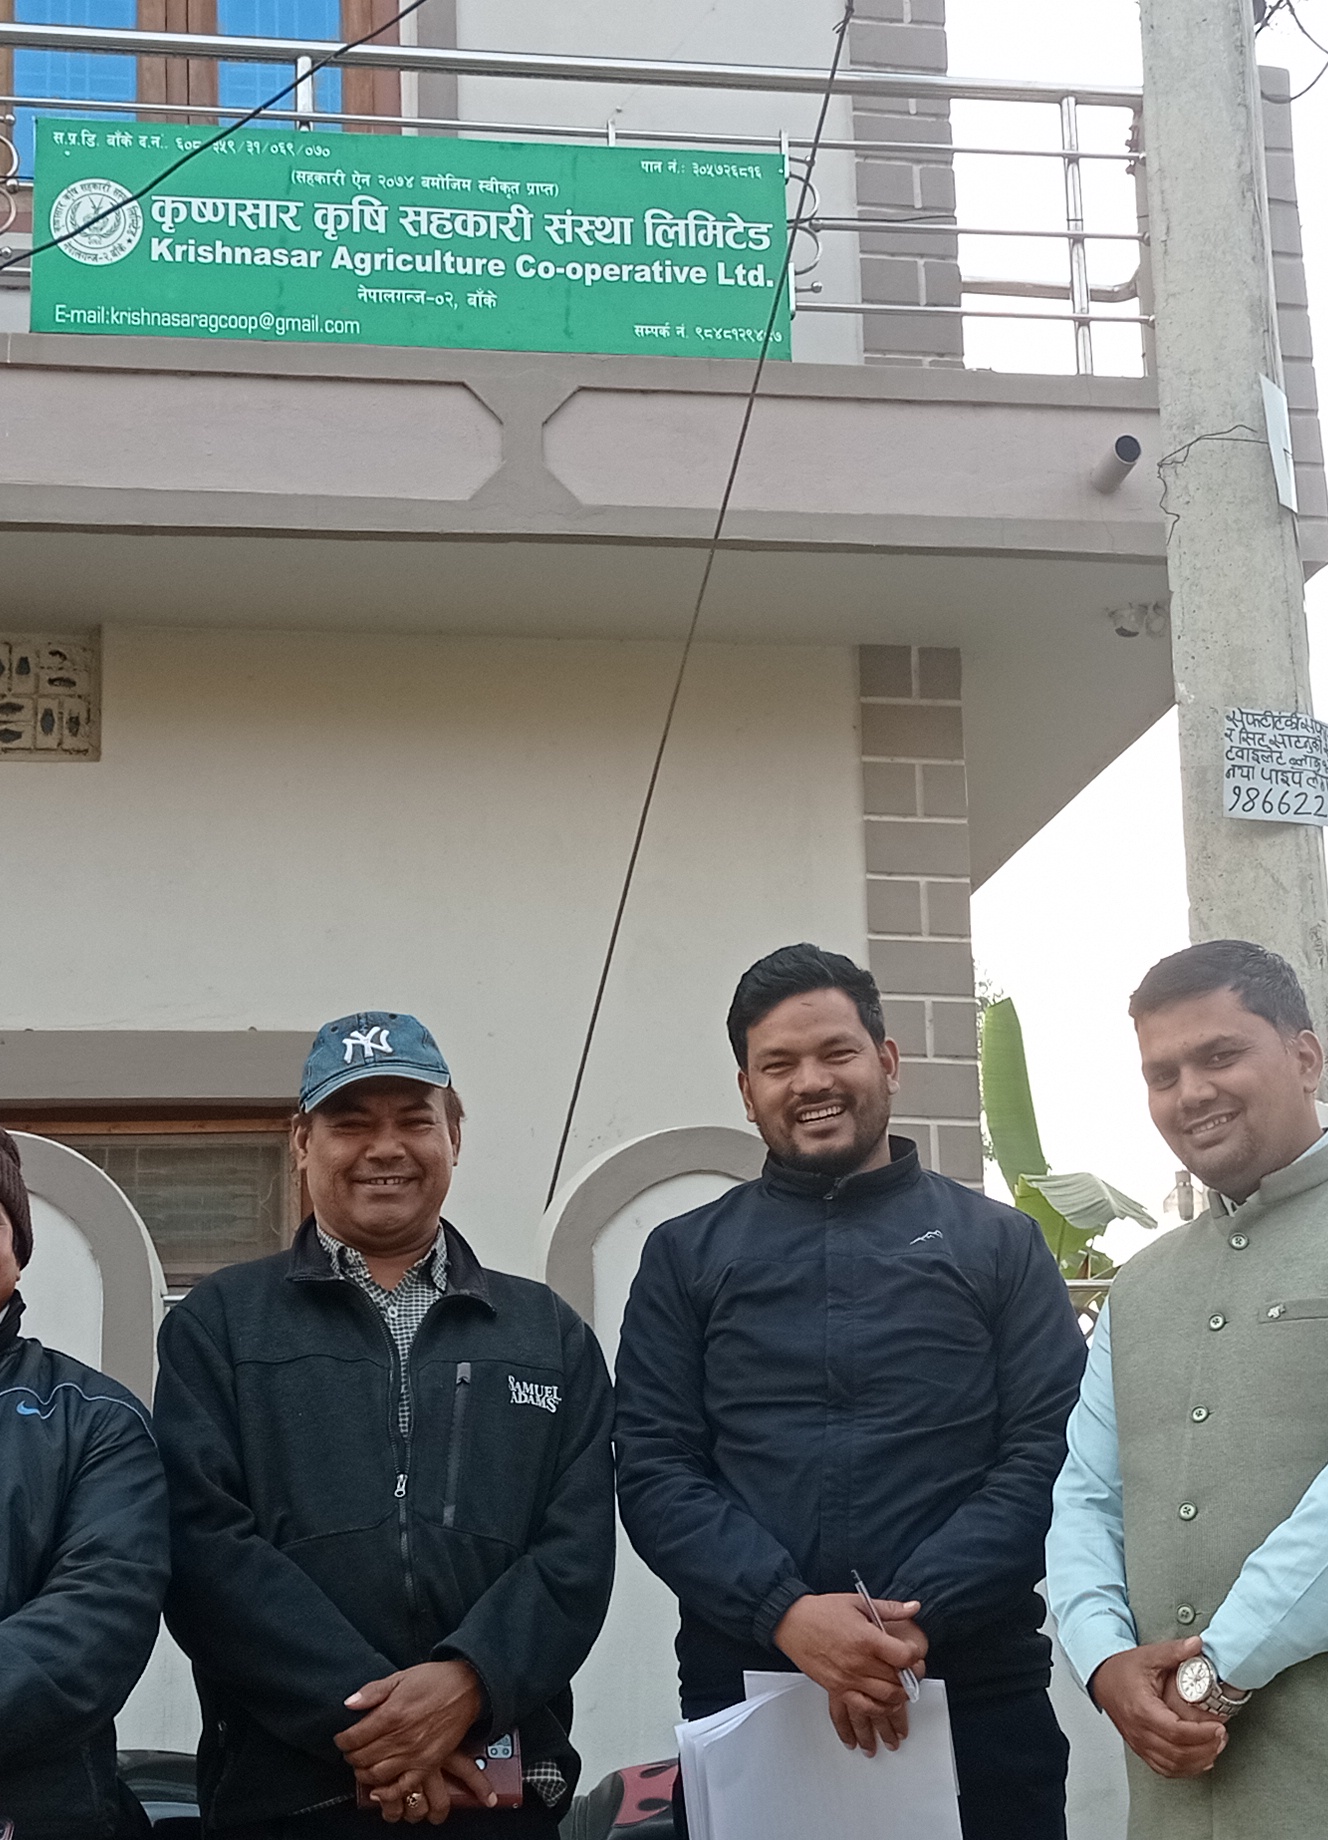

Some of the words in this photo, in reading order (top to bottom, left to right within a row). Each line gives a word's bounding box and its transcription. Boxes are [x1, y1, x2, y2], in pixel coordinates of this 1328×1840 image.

[107, 130, 133, 147] बाँके
[641, 161, 662, 172] पान
[292, 169, 346, 186] (सहकारी
[352, 170, 371, 190] ऐन
[378, 175, 414, 188] २०७४
[421, 174, 472, 191] बमोजिम
[478, 177, 520, 199] स्वीकृत
[527, 183, 558, 197] प्राप्त)
[151, 195, 304, 232] कृष्णसार
[314, 195, 388, 240] कृषि
[399, 204, 534, 241] सहकारी
[544, 209, 634, 245] संस्था
[644, 209, 773, 250] लिमिटेड
[151, 237, 322, 267] Krishnasar
[331, 246, 505, 276] Agriculture
[516, 254, 707, 285] Co-operative
[718, 262, 774, 287] Ltd.
[467, 288, 497, 308] बाँके
[55, 305, 359, 334] E-mail:krishnasaragcoop@gmail.com
[634, 322, 670, 337] सम्पर्क
[696, 326, 782, 342] ९८४८१२९४७
[508, 1374, 562, 1402] SAMUEL
[510, 1390, 557, 1413] ADAMS
